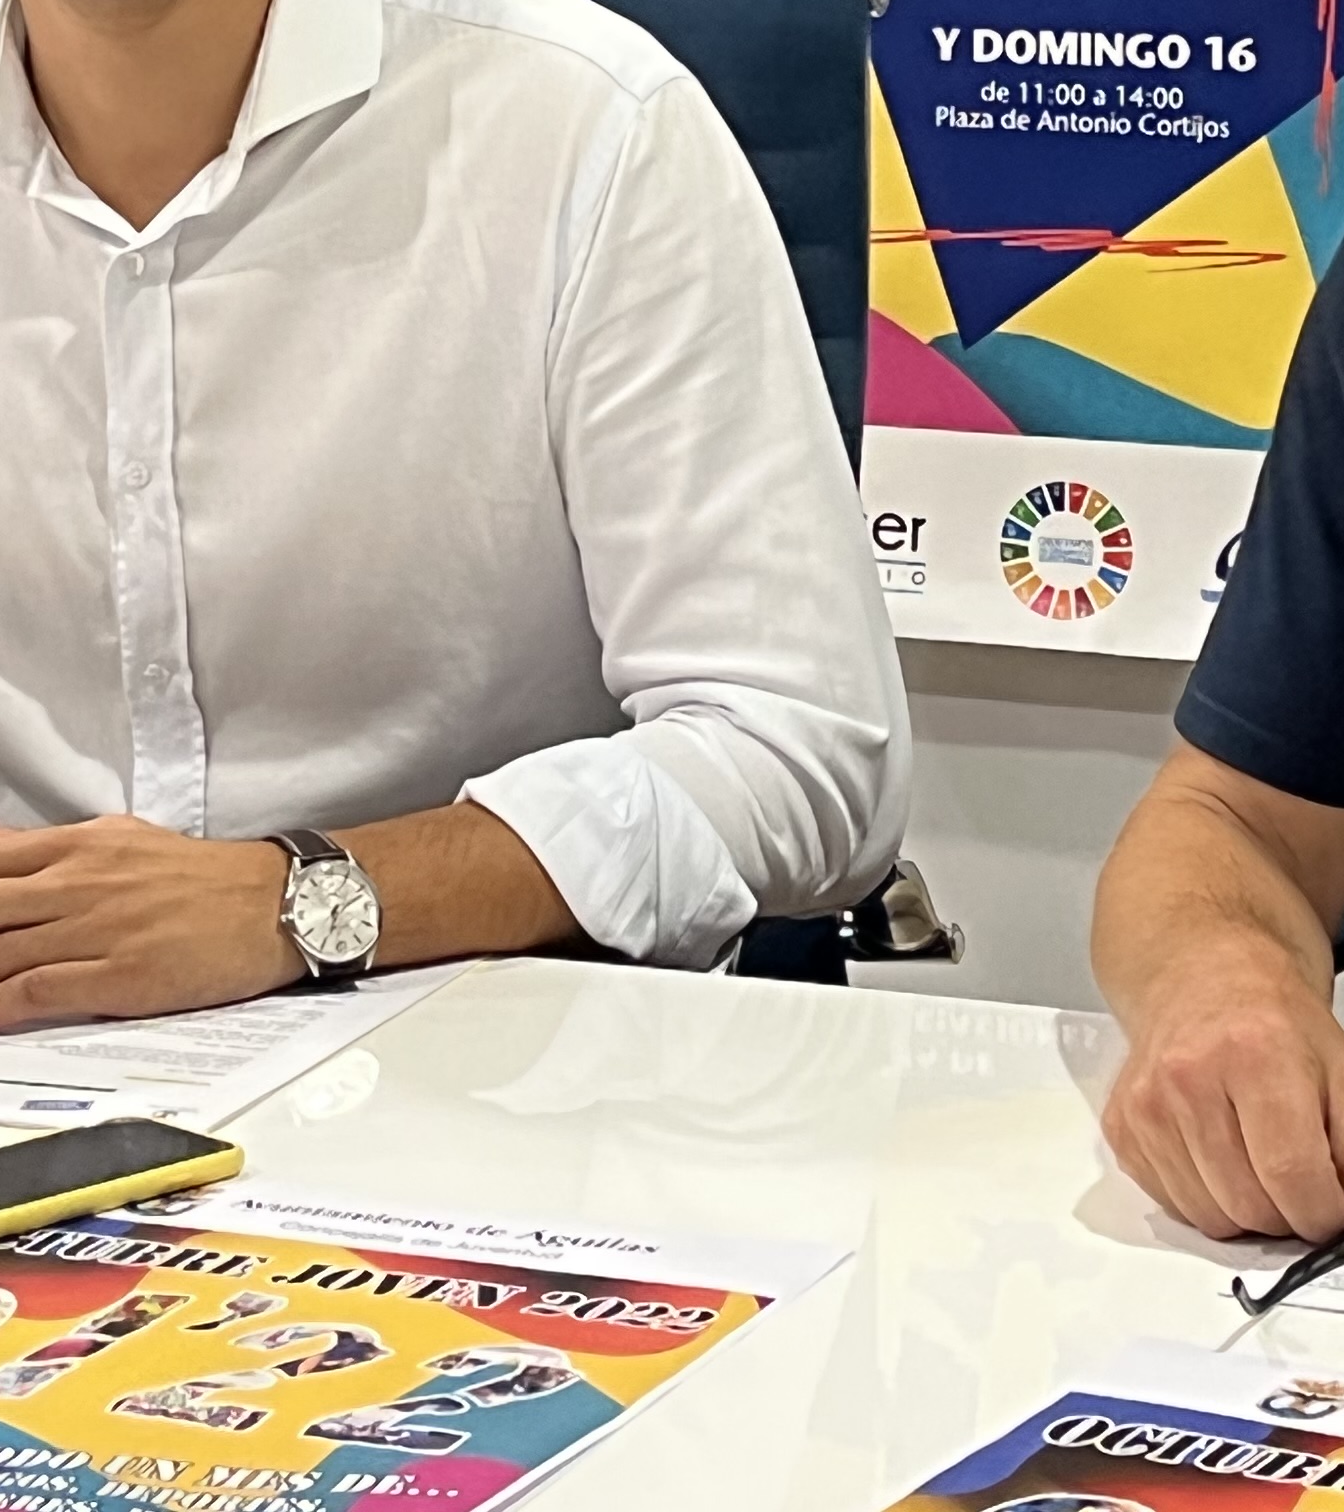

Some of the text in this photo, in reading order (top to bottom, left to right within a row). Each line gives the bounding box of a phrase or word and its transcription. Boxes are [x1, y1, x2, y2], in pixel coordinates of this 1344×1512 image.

[932, 27, 1258, 74] Y DOMINGO 16
[980, 81, 1184, 110] de 11:00 a 14:00
[935, 105, 1231, 144] Plaza de Antonio Cortijos
[269, 1259, 528, 1311] JOVEN
[541, 1289, 721, 1333] 2022
